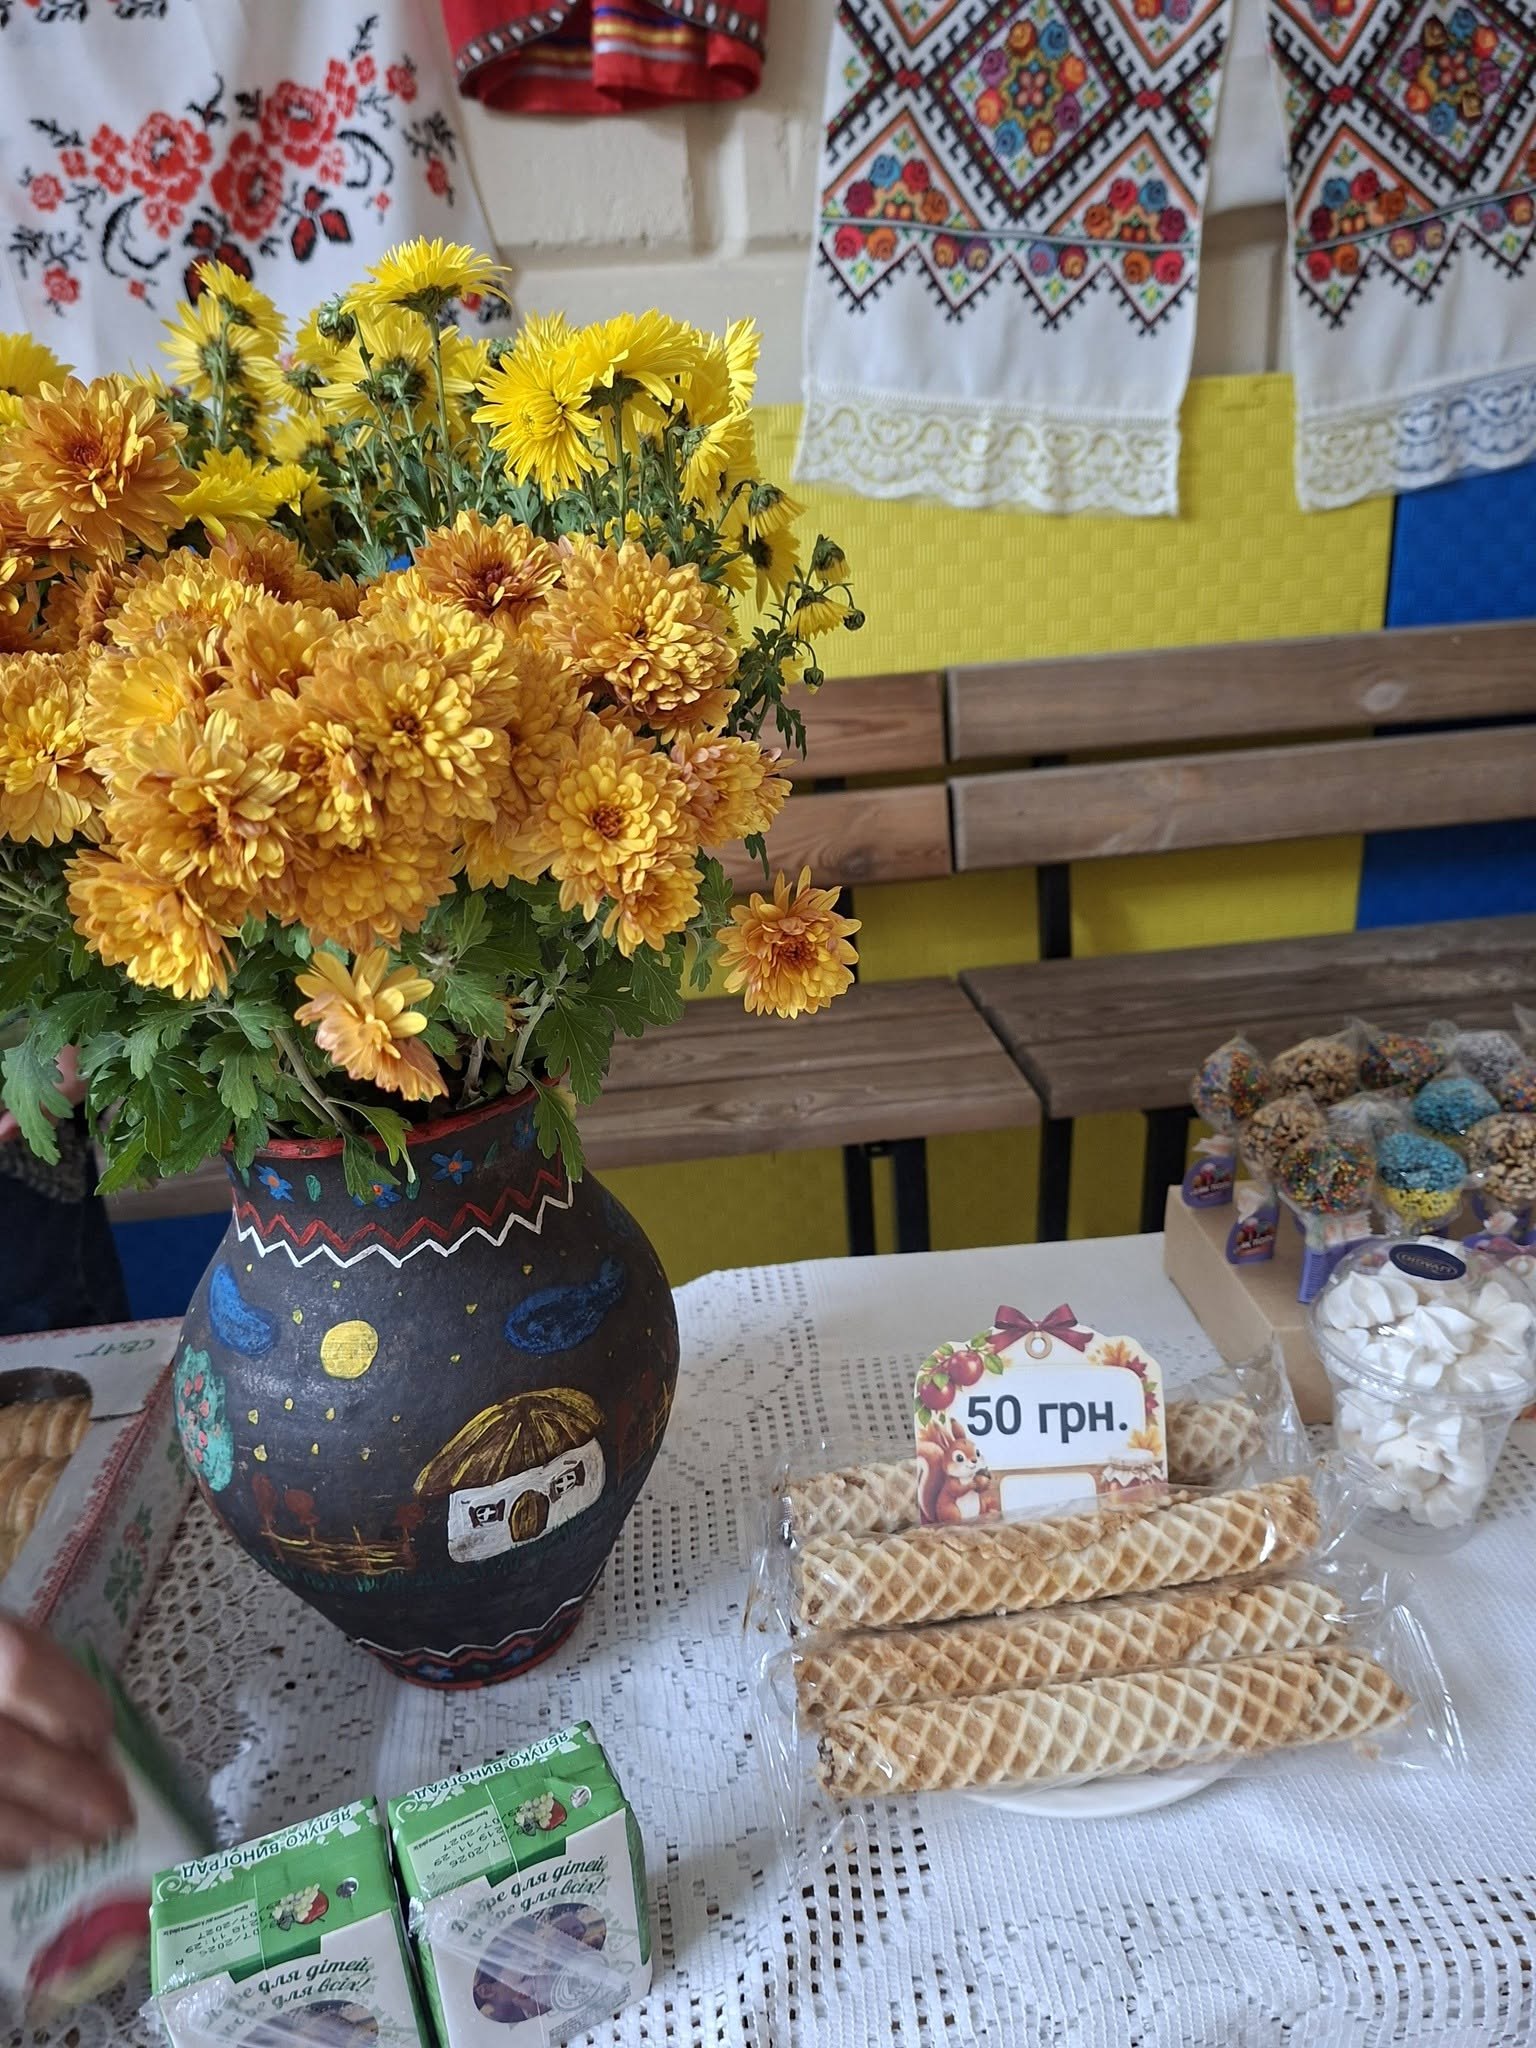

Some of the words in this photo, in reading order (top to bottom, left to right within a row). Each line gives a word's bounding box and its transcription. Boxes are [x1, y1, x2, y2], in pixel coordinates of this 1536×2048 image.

[966, 1394, 1021, 1436] 50
[1038, 1400, 1128, 1444] грн.
[510, 1869, 550, 1898] для
[520, 1887, 557, 1913] для
[257, 1970, 302, 1993] для
[271, 1987, 312, 2010] для
